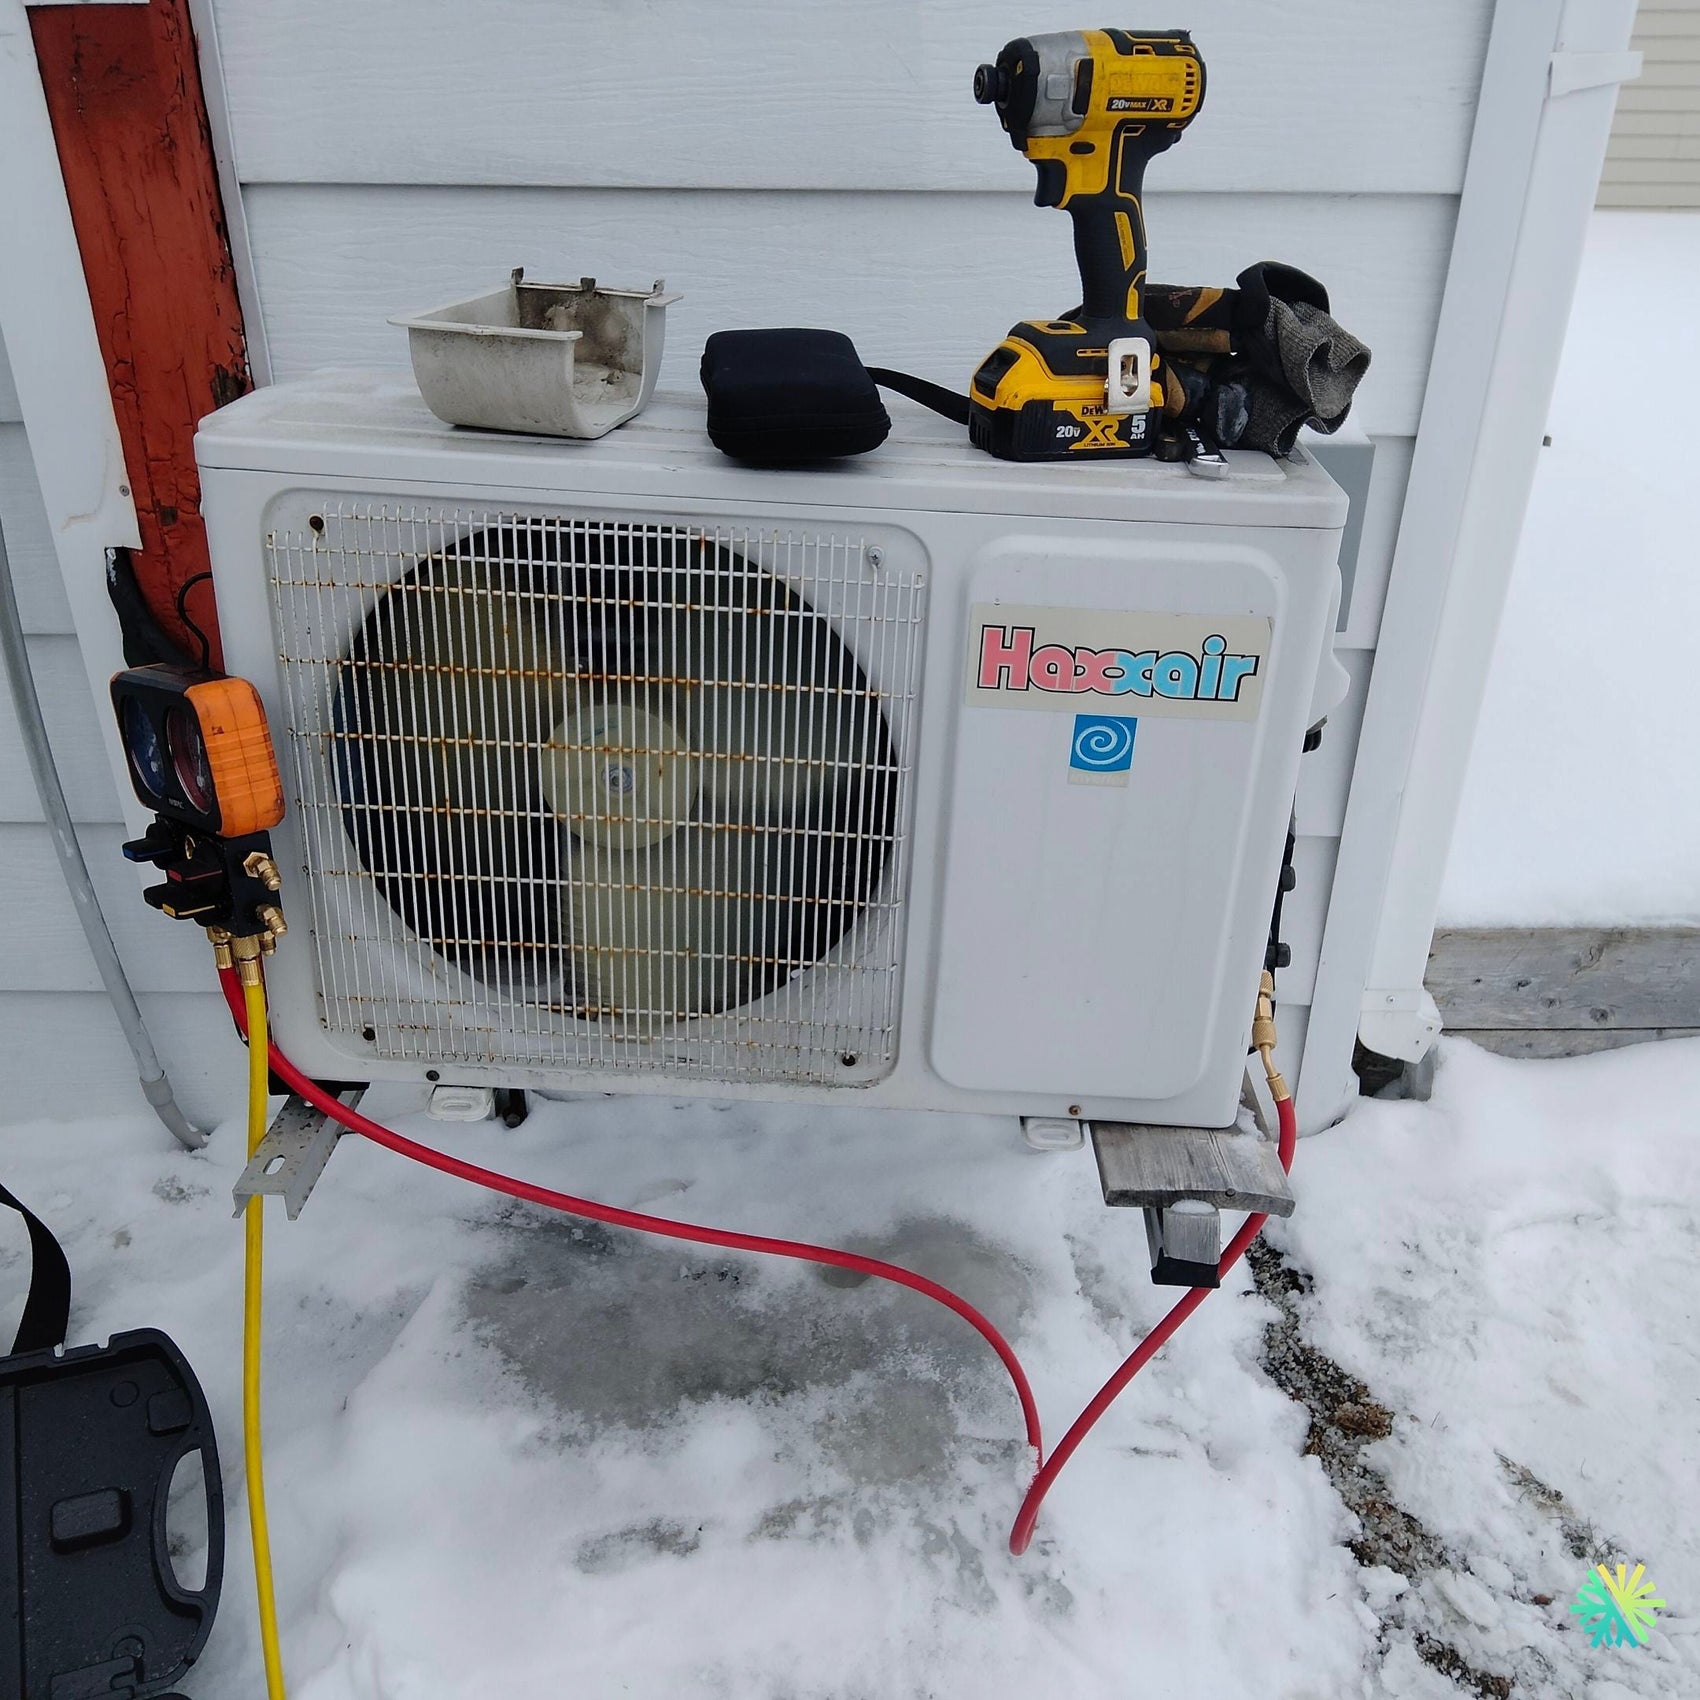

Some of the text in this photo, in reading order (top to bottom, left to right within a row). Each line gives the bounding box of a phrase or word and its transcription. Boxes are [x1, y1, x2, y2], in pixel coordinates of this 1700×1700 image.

[1056, 414, 1147, 442] 20V XR 5
[977, 624, 1260, 702] Haxxair
